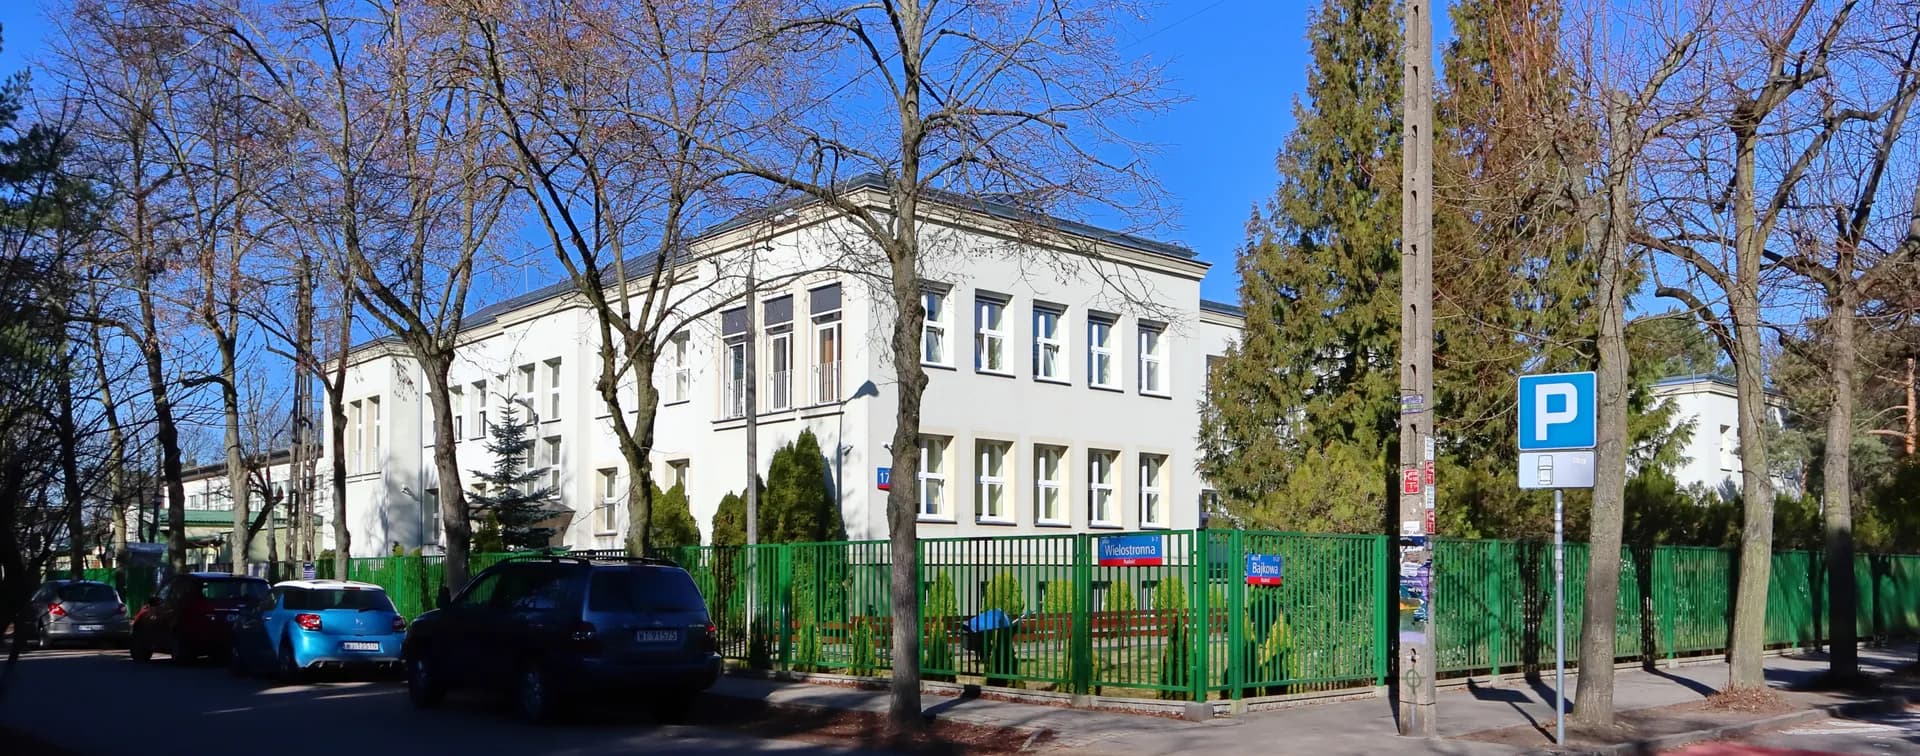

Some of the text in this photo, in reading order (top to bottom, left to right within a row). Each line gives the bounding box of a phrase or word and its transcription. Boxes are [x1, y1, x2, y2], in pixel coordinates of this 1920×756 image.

[1535, 382, 1578, 441] P
[879, 471, 890, 484] 17
[1104, 544, 1156, 557] Wielostronna
[1252, 561, 1278, 577] Bajkowa
